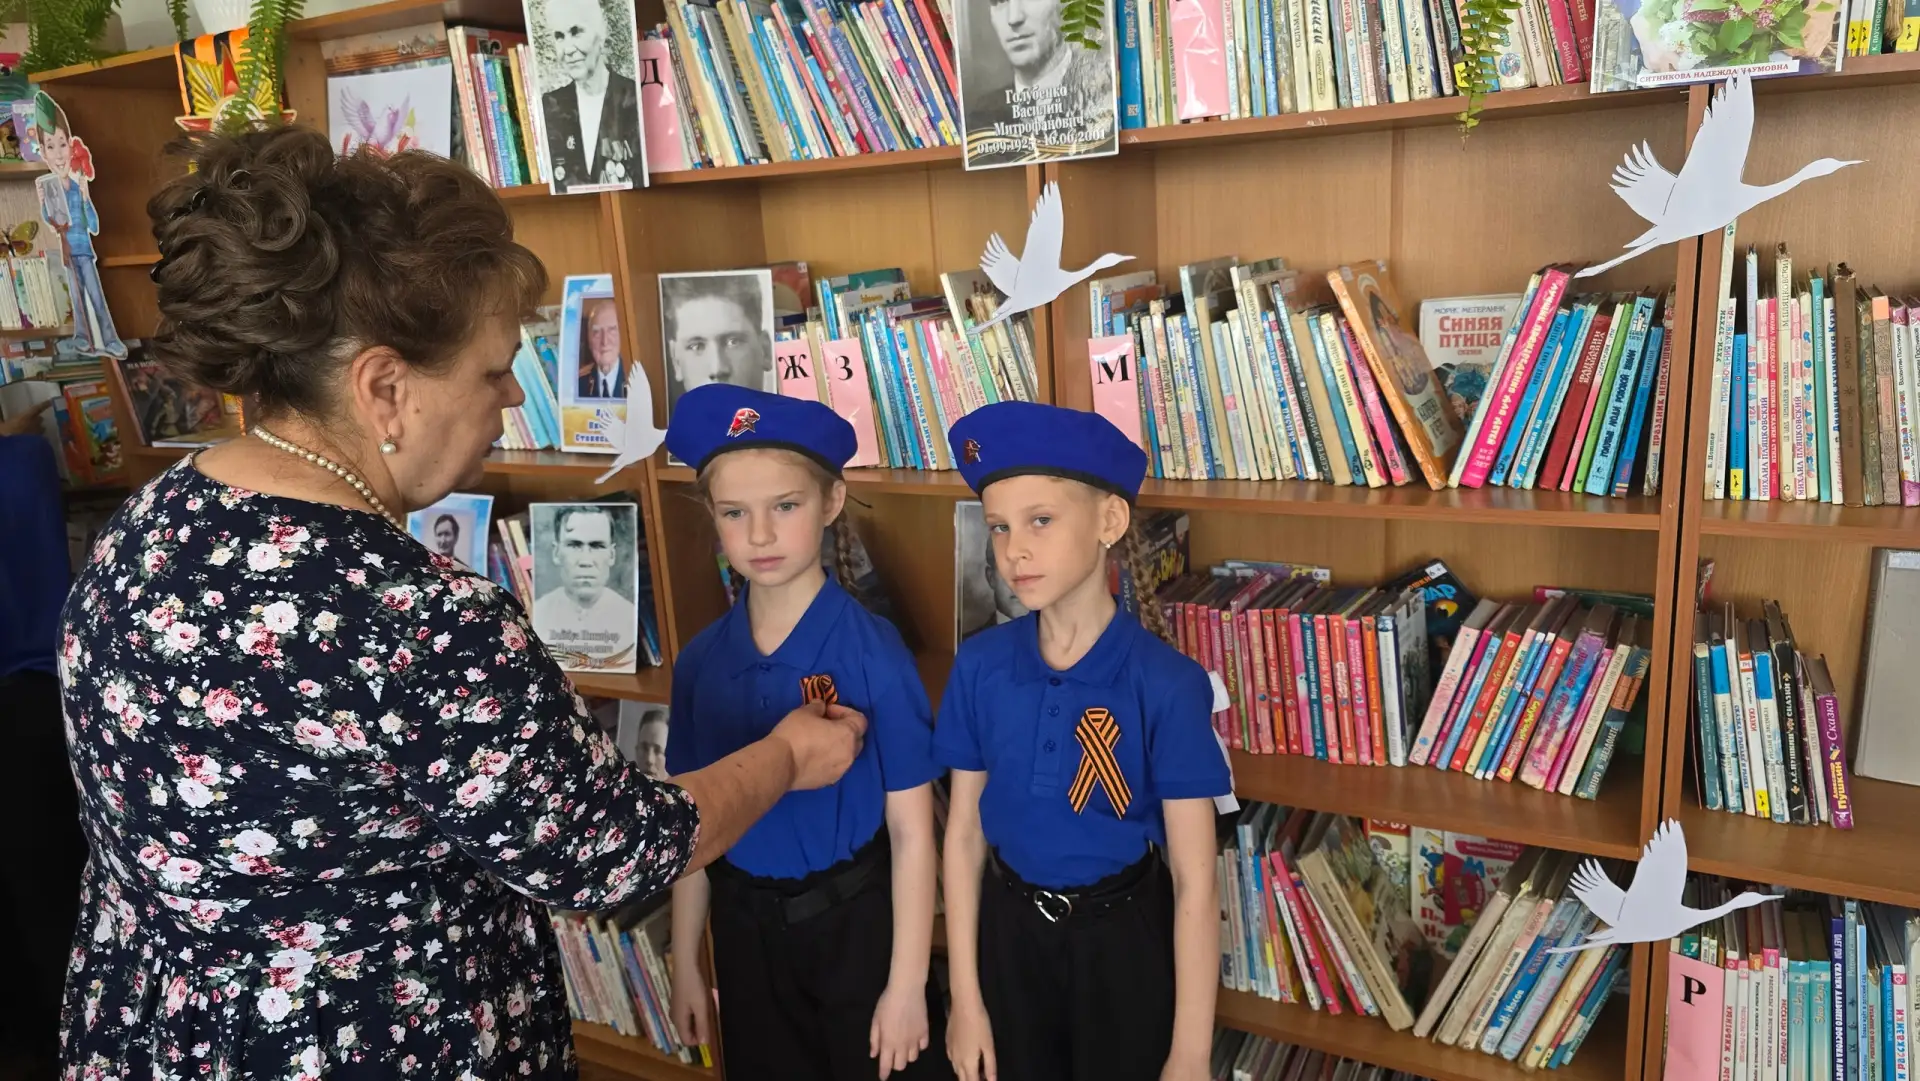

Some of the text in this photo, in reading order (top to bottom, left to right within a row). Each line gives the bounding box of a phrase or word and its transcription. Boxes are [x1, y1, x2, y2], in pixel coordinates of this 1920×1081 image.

[1560, 40, 1576, 69] ОНИКС
[641, 56, 665, 89] Д
[1640, 73, 1691, 83] СИТНИКОВА
[1694, 68, 1737, 78] НАДЕЖДА
[855, 81, 878, 123] ИСТОРИИ
[1005, 84, 1067, 104] Голубенко
[1012, 98, 1063, 119] Василий
[994, 115, 1084, 136] Митрофанович
[977, 138, 1035, 154] 01.09.1925
[778, 354, 810, 380] Ж
[835, 355, 853, 381] З
[905, 355, 916, 381] УТРАМ
[1096, 353, 1132, 385] М
[1577, 329, 1603, 383] ФАНТАЗИИ
[1582, 330, 1608, 383] БАРАНКИНА
[1652, 328, 1676, 445] ПРАЗДНИК НЕПОСЛУШАНИЯ
[1722, 345, 1733, 401] ПРИКЛЮЧЕНИЯ
[912, 383, 919, 393] ПО
[915, 394, 925, 415] ГОСТИ
[1498, 394, 1513, 416] ДЛЯ
[1608, 404, 1622, 426] ЛЮДИ
[923, 425, 934, 449] ХОДИТ
[1282, 407, 1296, 442] СКАЗКИ
[1302, 390, 1330, 471] СЕРГЕЙ МИХАЛКОВ
[1486, 416, 1505, 446] ДЕТЕЙ
[929, 450, 937, 464] КТО
[1784, 682, 1794, 716] СКАЗКИ
[1749, 707, 1757, 731] СКАЗКИ
[1825, 699, 1838, 740] Сказки
[1734, 704, 1742, 729] СКАЗКА
[1738, 736, 1746, 761] РЫБАКЕ
[1742, 768, 1750, 788] РЫБКЕ
[1587, 770, 1603, 793] ПЯТЕРО
[1835, 761, 1848, 809] Пушкин
[1835, 962, 1843, 988] СКАЗКИ
[1505, 986, 1525, 1014] Носов
[1680, 974, 1707, 1006] Р
[1725, 1005, 1734, 1051] ЖИВОТНЫХ
